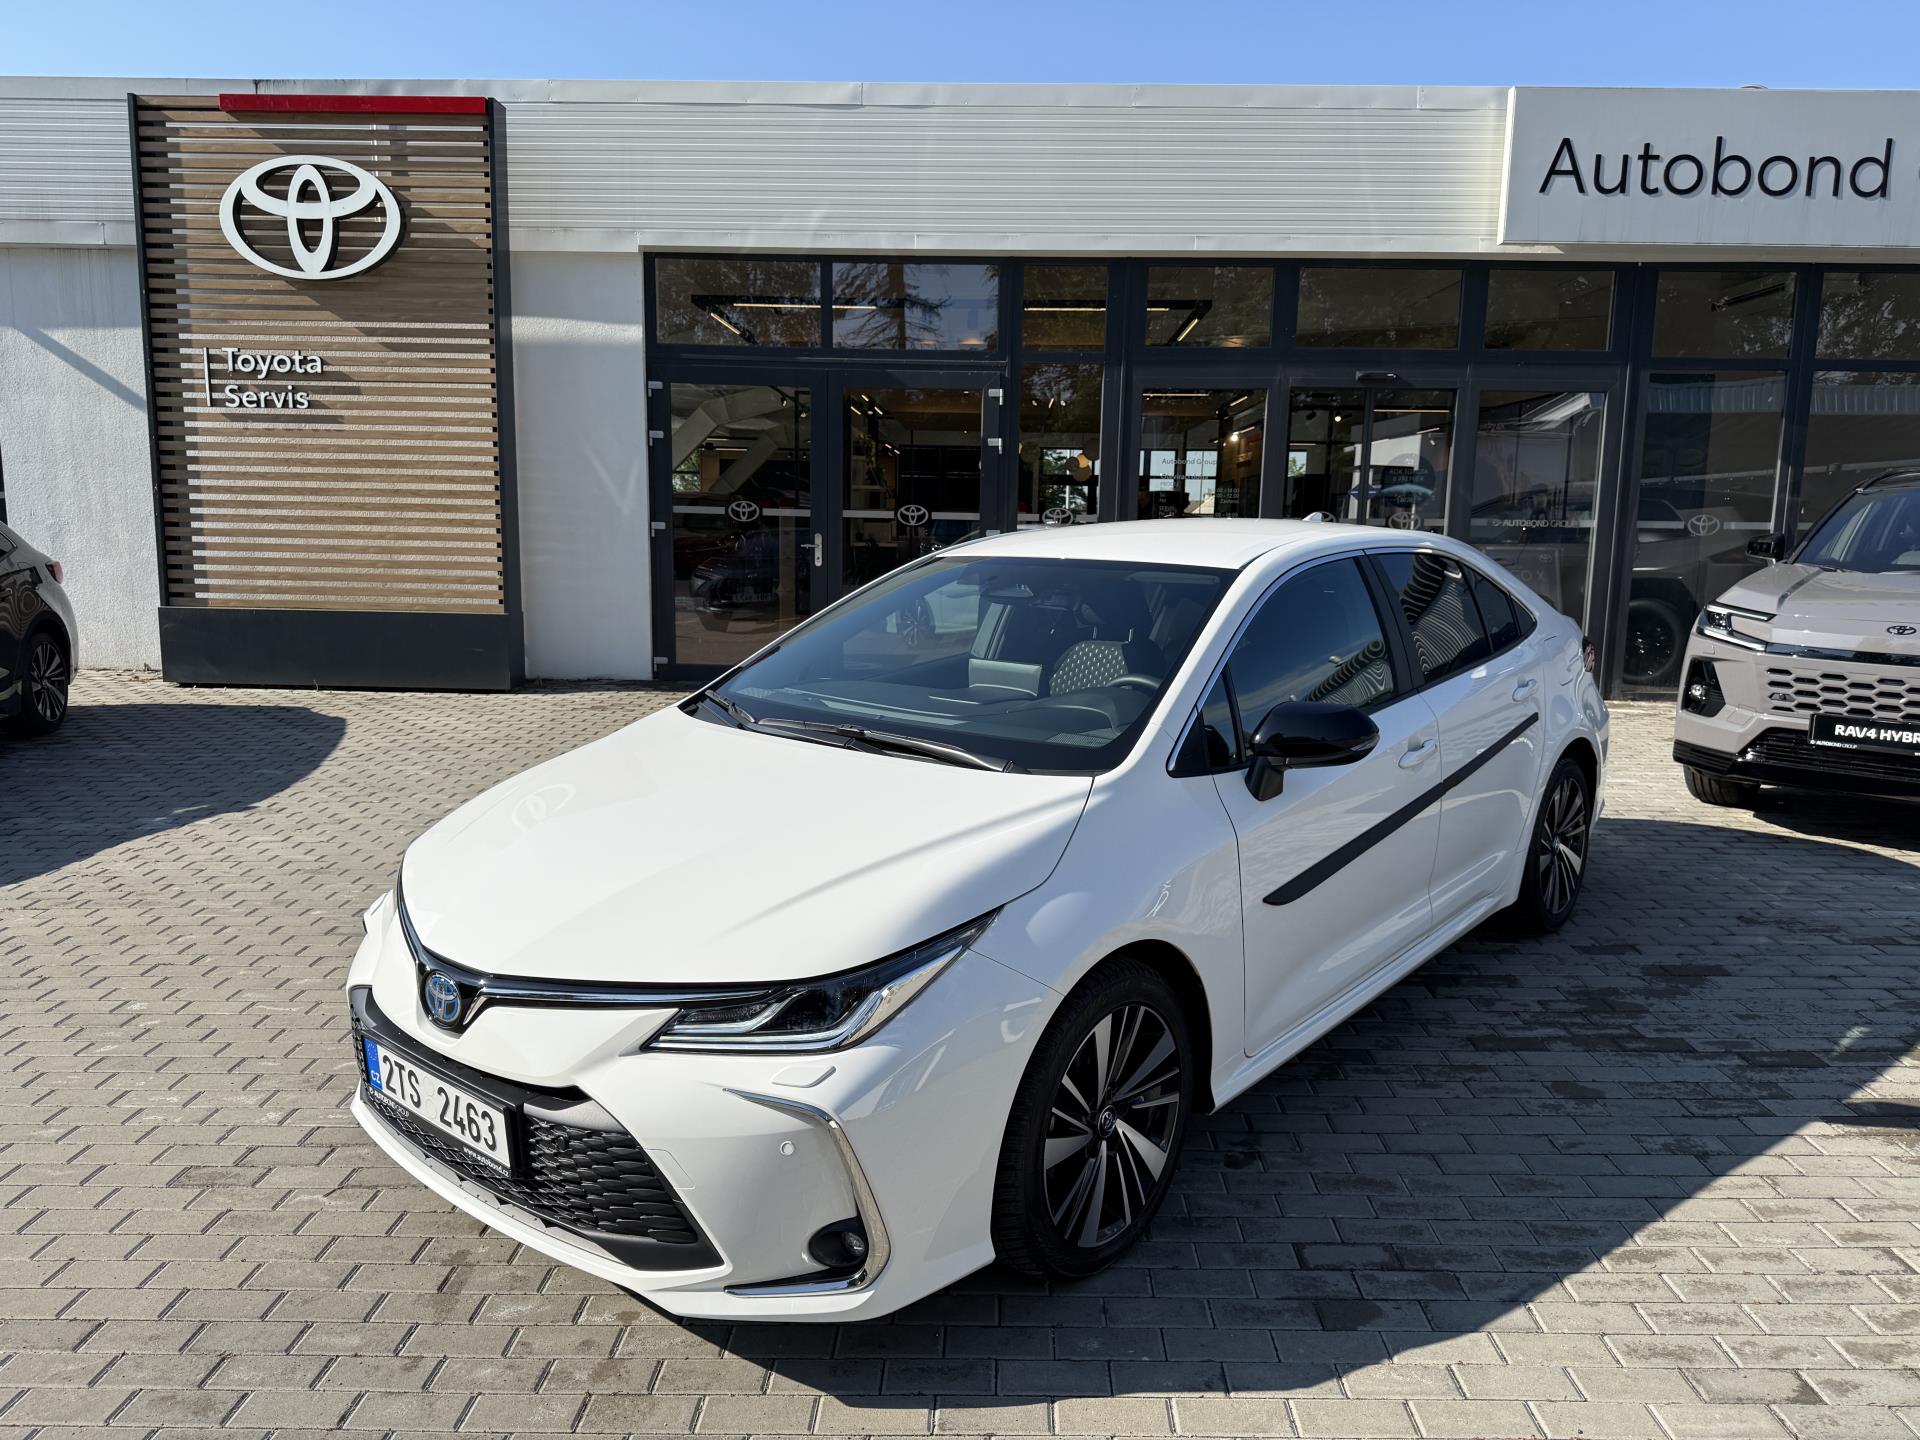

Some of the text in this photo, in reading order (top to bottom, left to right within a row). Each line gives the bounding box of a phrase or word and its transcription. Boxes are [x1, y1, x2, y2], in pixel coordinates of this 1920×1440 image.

[1539, 136, 1894, 198] Autobond
[221, 347, 322, 379] Toyota
[224, 384, 309, 409] Servis
[1502, 519, 1578, 528] AUTOBOND GROUP
[1834, 724, 1920, 744] RAV4 HYBR
[370, 1070, 381, 1083] CZ
[382, 1054, 497, 1152] 2TS 2463
[463, 1146, 509, 1178] www.autobond.cz
